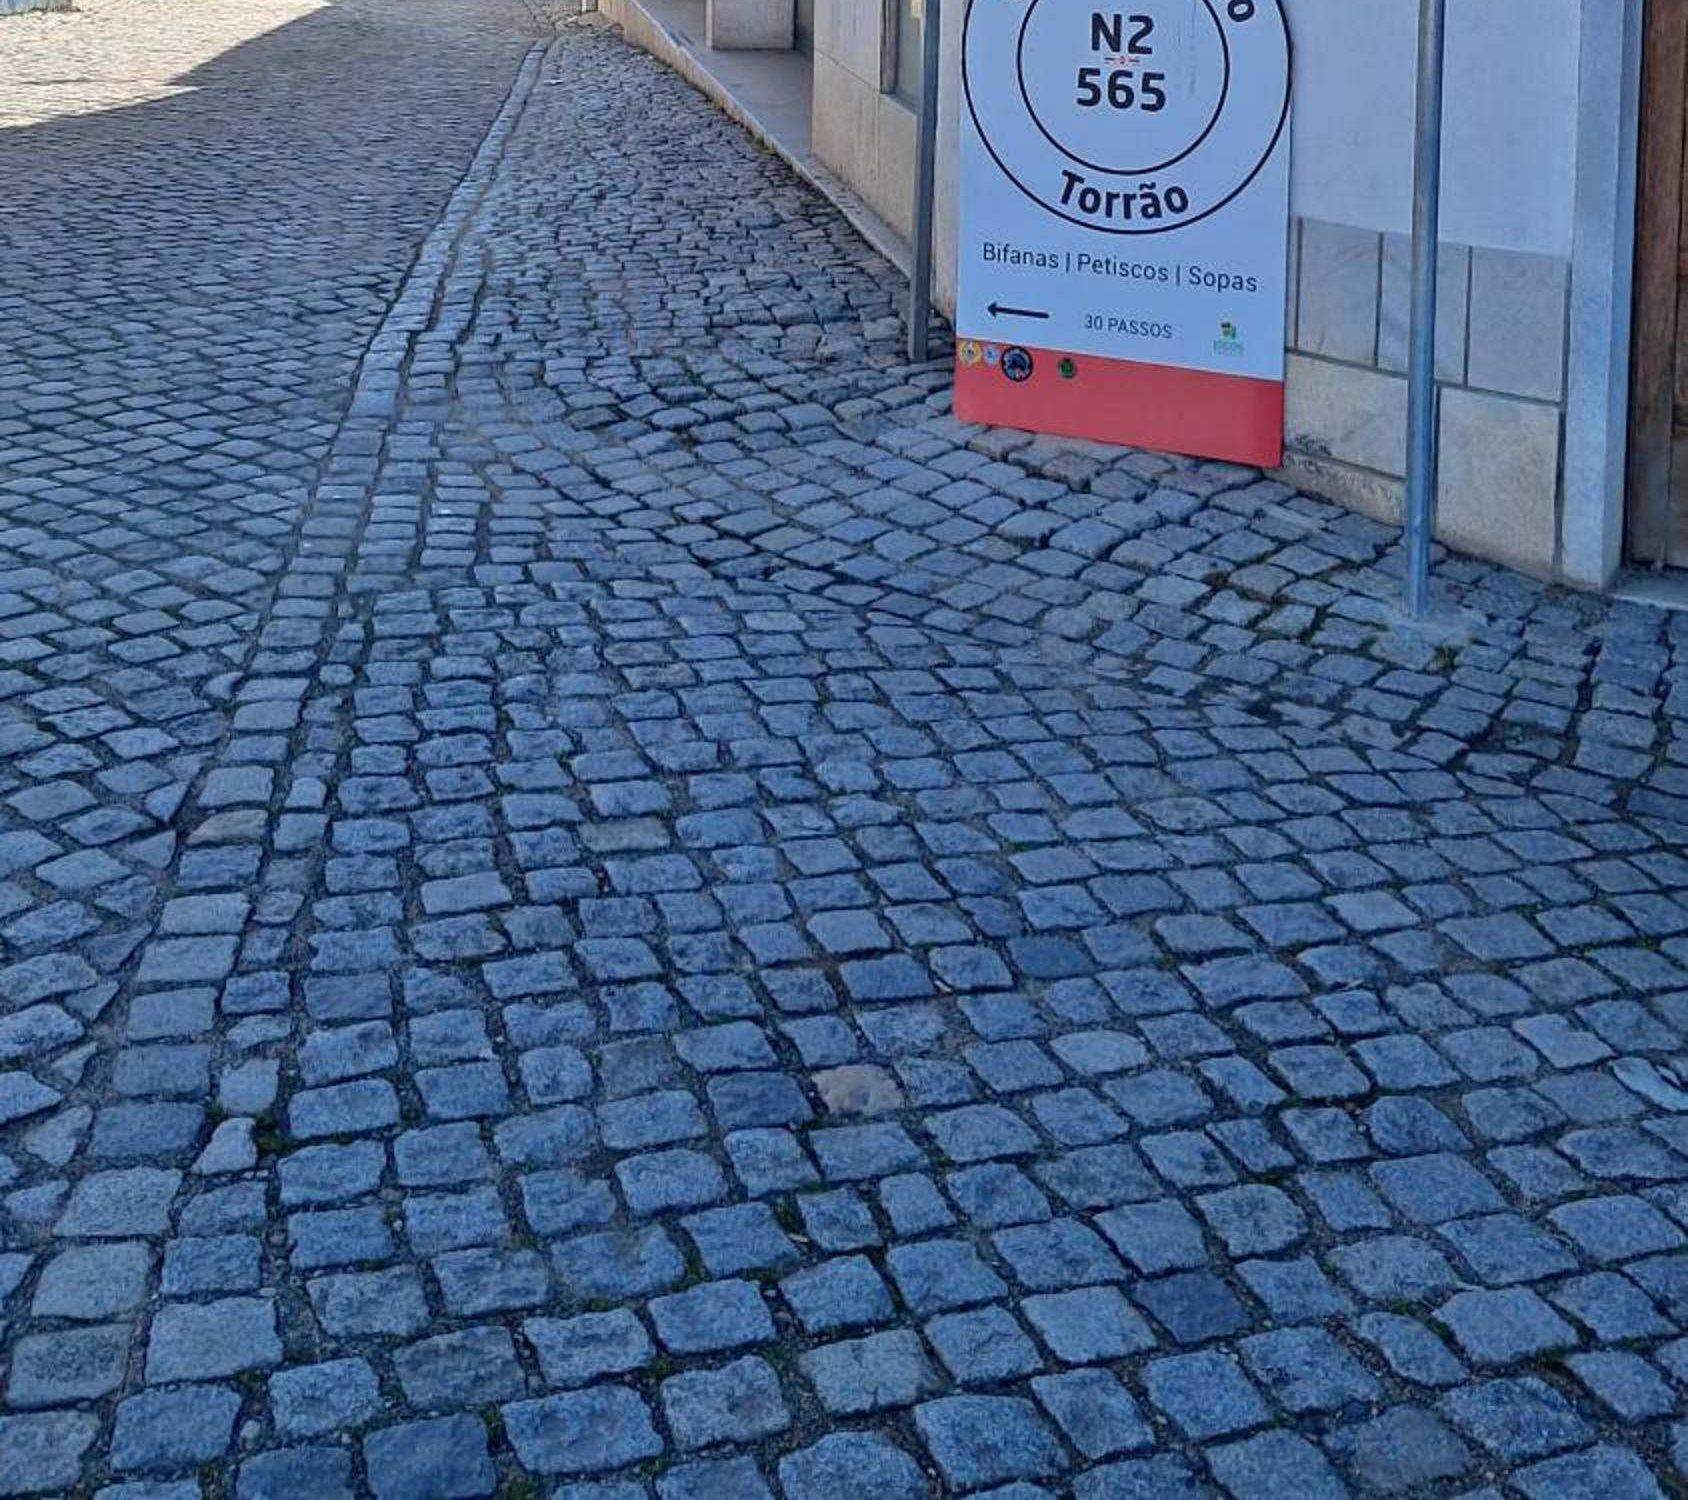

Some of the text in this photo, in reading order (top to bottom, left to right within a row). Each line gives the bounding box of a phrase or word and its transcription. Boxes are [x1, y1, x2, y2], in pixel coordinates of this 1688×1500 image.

[1091, 12, 1155, 55] N2
[1076, 67, 1167, 113] 565
[1059, 170, 1189, 220] Torrão
[982, 241, 1059, 269] Bifanas
[1076, 253, 1169, 283] Petiscos
[1188, 265, 1258, 293] Sopas
[1085, 314, 1173, 340] 30 PASSOS
